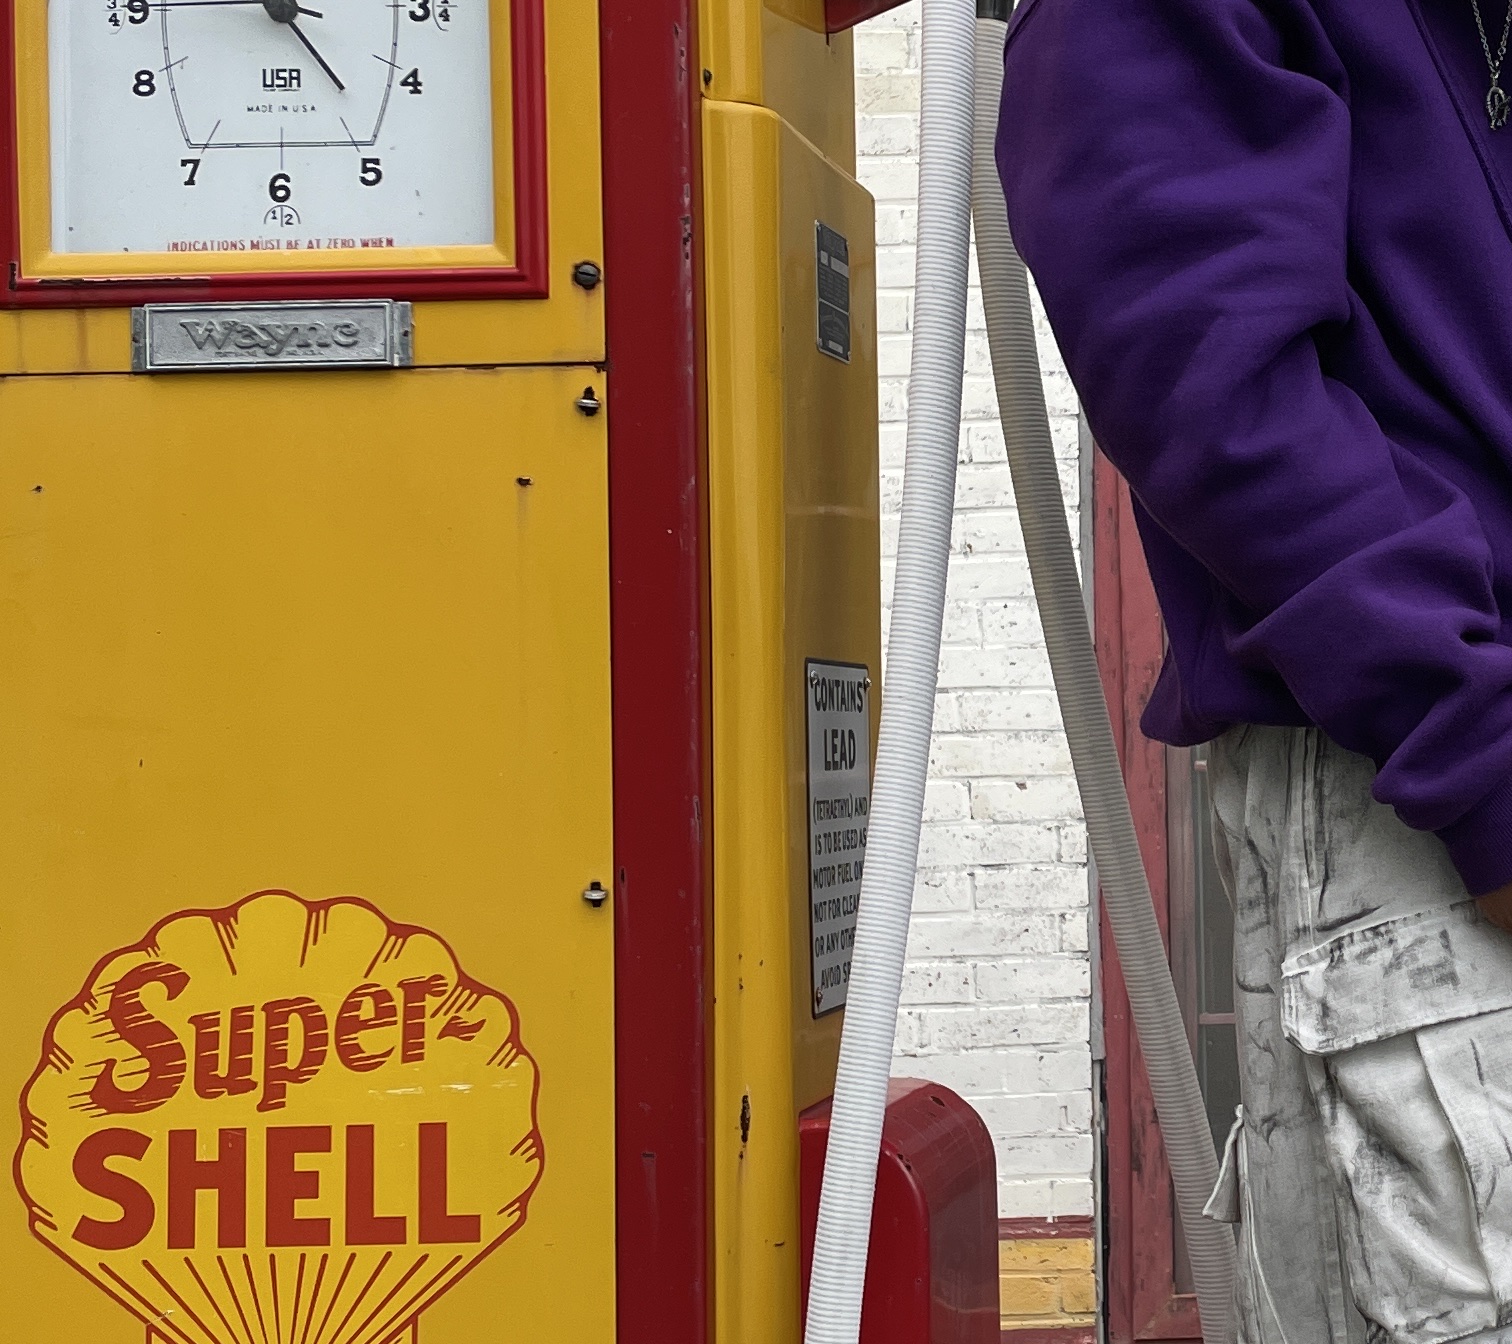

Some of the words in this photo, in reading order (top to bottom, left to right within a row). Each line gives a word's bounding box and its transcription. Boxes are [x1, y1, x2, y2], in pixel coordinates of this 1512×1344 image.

[132, 70, 156, 97] 8
[262, 68, 301, 88] USA
[399, 68, 423, 95] 4
[246, 104, 273, 113] MADE
[278, 104, 288, 112] IN
[180, 159, 201, 186] 7
[359, 158, 383, 186] 5
[269, 172, 291, 203] 6
[167, 239, 246, 252] INDICATIONS
[250, 238, 281, 251] MUST
[286, 238, 302, 250] BE
[306, 238, 321, 250] AT
[327, 237, 355, 249] ZERO
[360, 237, 395, 249] WHEN
[179, 318, 361, 357] Wayne
[814, 676, 864, 714] CONTAINS
[823, 728, 857, 772] LEAD
[854, 796, 868, 817] AND
[814, 833, 822, 856] IS
[823, 832, 832, 854] TO
[833, 830, 842, 852] BE
[842, 829, 858, 851] USED
[859, 827, 867, 848] AS
[813, 865, 836, 890] MOTOR
[838, 862, 853, 884] FUEL
[813, 900, 827, 924] NOT
[828, 897, 841, 920] FOR
[814, 936, 825, 958] OR
[826, 932, 840, 955] ANY
[71, 1121, 482, 1252] SHELL
